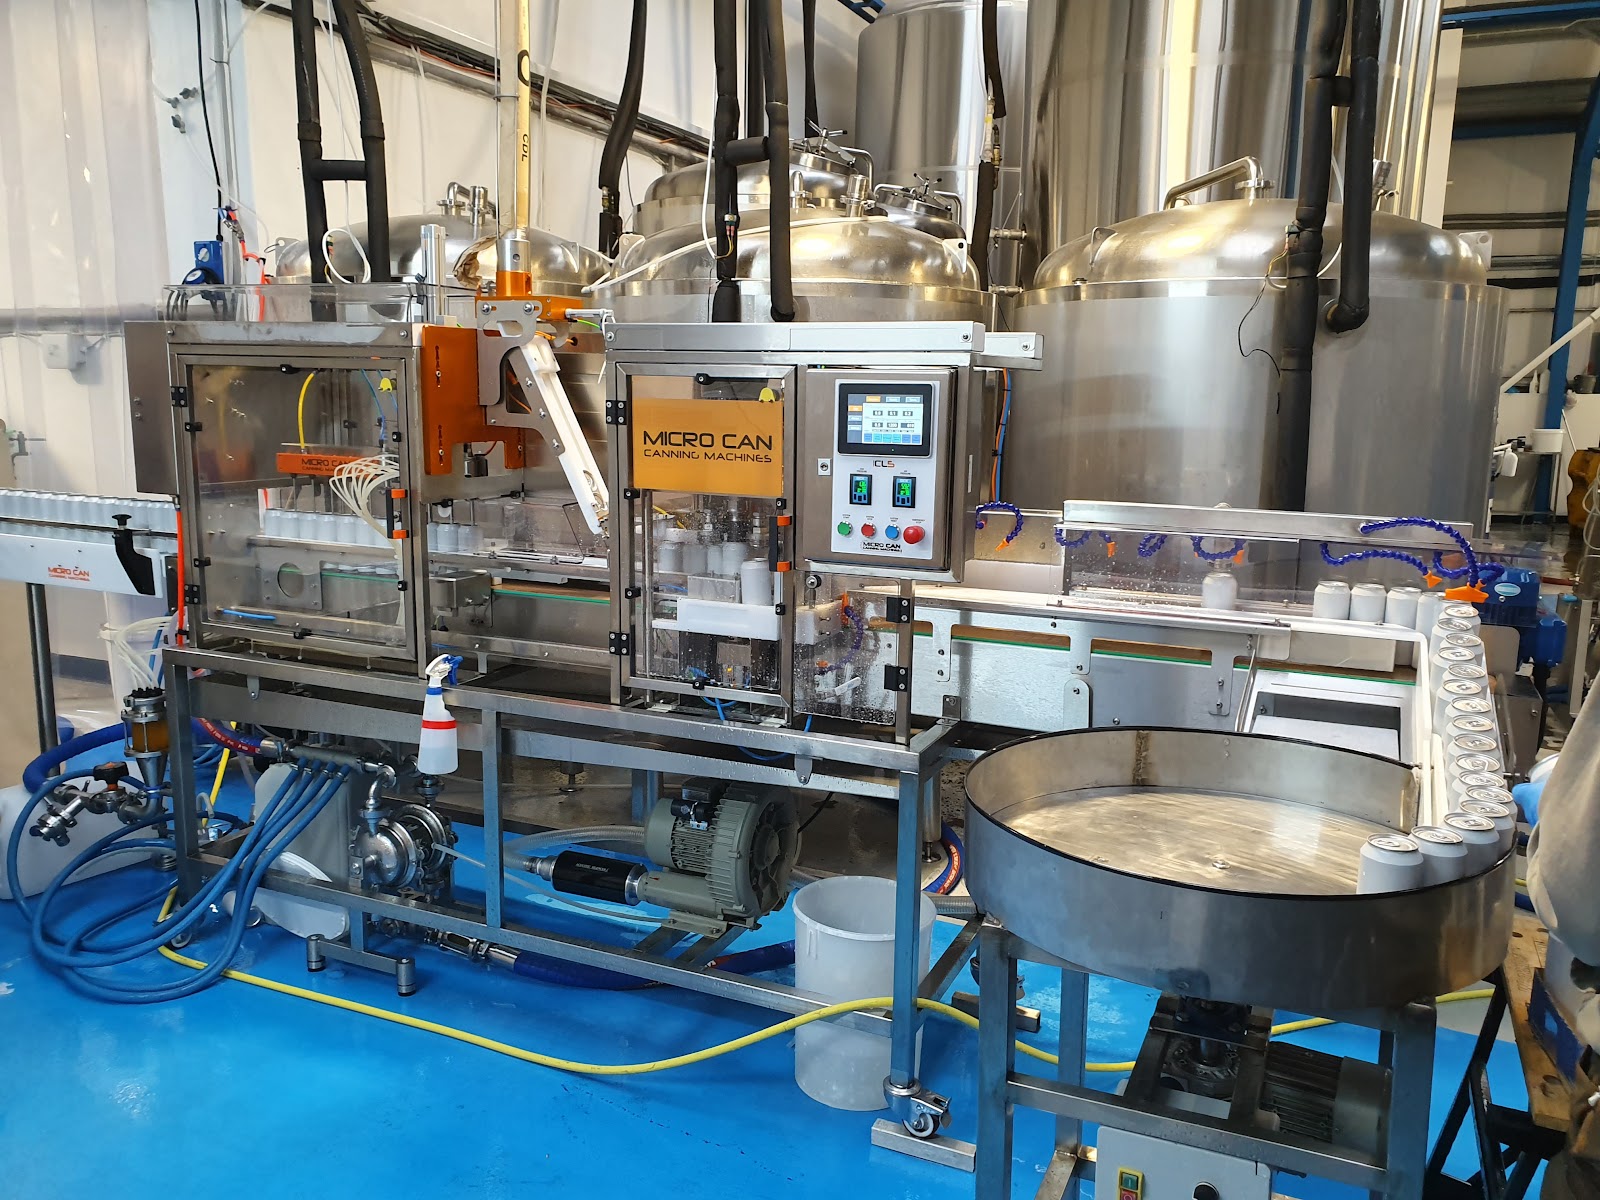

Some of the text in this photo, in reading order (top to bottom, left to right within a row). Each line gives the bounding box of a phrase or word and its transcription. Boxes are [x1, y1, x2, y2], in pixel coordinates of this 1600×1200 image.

[521, 133, 529, 162] CDL
[643, 430, 773, 451] MICRO CAN
[301, 458, 330, 467] MICRO
[643, 448, 772, 463] CANNING MACHINES
[862, 541, 885, 549] MICRO
